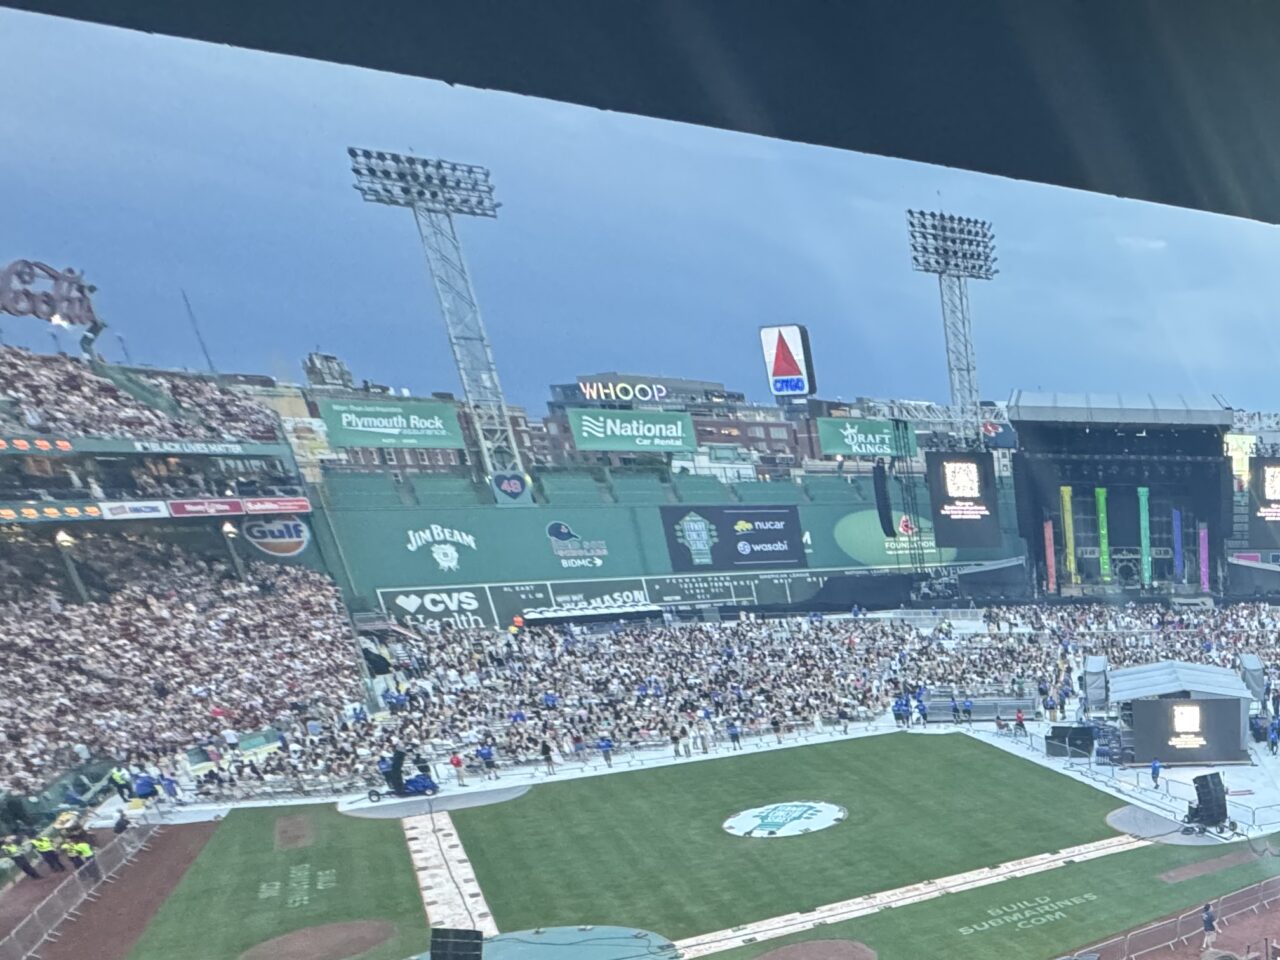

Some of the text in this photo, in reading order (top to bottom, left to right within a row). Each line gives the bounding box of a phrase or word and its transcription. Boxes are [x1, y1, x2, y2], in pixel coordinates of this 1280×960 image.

[578, 382, 667, 401] WHOOP
[772, 377, 805, 392] CITGO
[341, 413, 444, 429] Plymouth Rock
[606, 418, 682, 437] National
[636, 438, 651, 446] Car
[844, 433, 891, 445] DRAFT
[852, 444, 891, 454] KINGS
[250, 524, 304, 540] Gulf
[754, 519, 785, 530] nucar
[430, 523, 477, 551] BEAM
[751, 540, 788, 551] wasabi
[561, 558, 593, 568] BIDMC
[423, 592, 479, 612] CVS
[958, 892, 1098, 935] SUBMARINES
[987, 896, 1051, 917] BUILD
[1015, 911, 1068, 932] .COM
